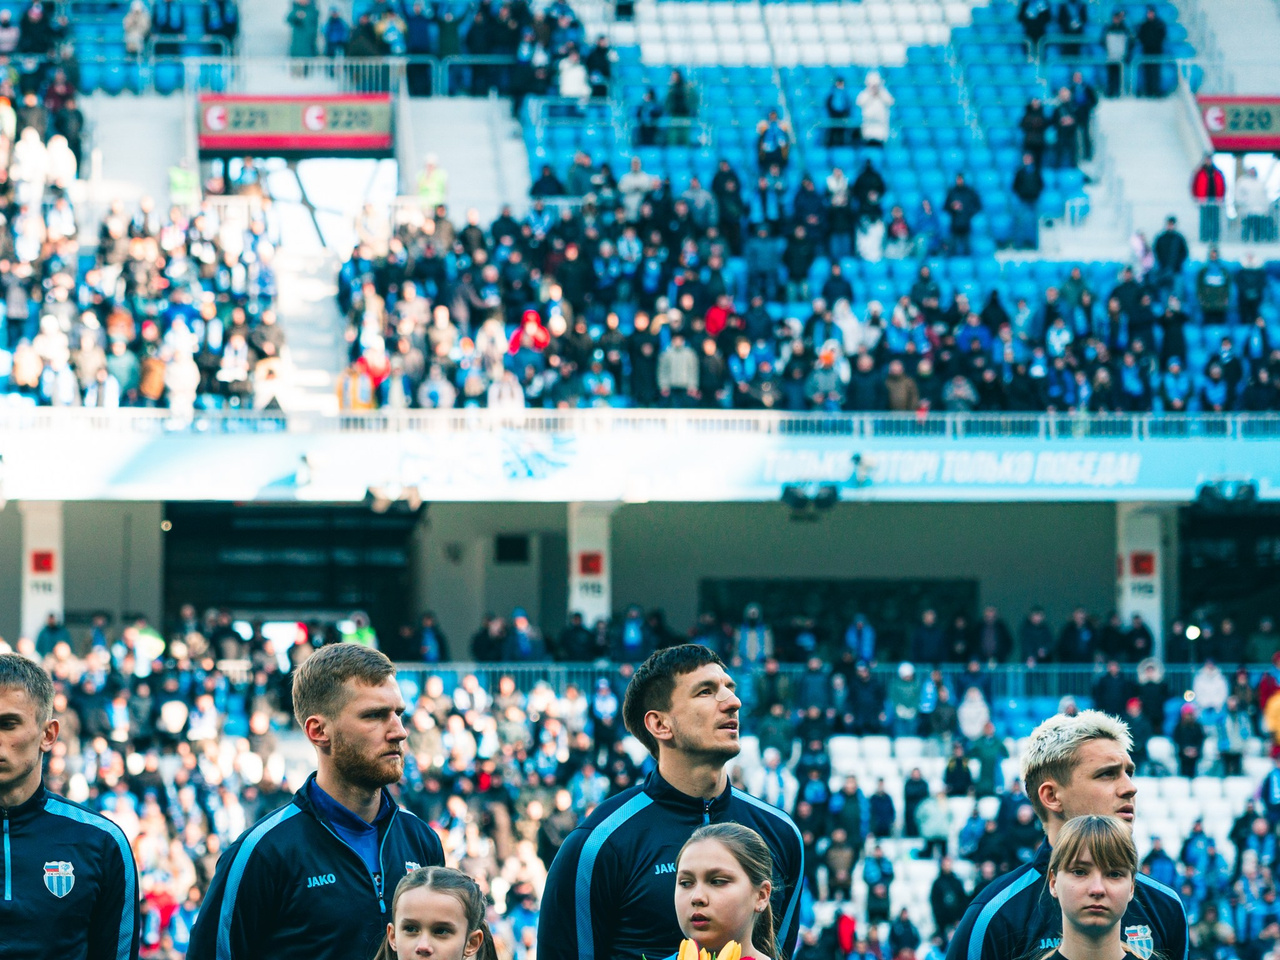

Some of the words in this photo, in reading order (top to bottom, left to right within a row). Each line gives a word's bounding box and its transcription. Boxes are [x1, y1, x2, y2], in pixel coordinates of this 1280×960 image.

[1229, 109, 1272, 130] 220
[654, 862, 677, 875] JAK
[307, 873, 336, 888] JAKO
[1040, 938, 1060, 949] JAK
